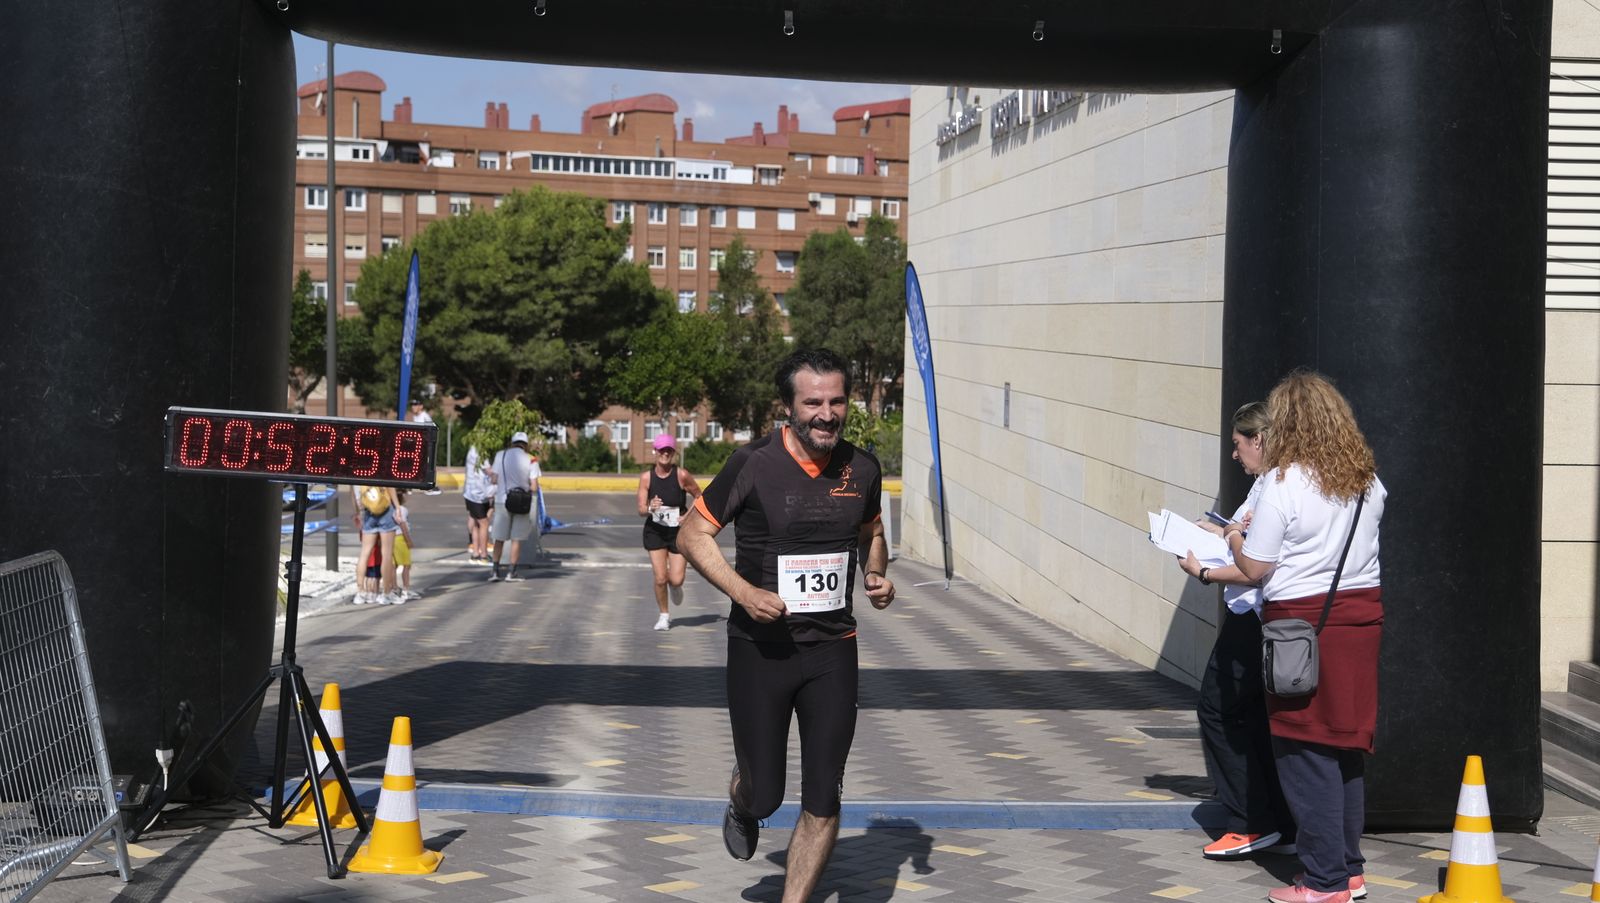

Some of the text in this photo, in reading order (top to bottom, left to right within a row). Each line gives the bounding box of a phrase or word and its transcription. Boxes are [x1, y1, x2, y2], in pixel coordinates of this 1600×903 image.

[180, 417, 423, 479] 00:52:58
[659, 512, 670, 520] 91
[795, 572, 838, 593] 130
